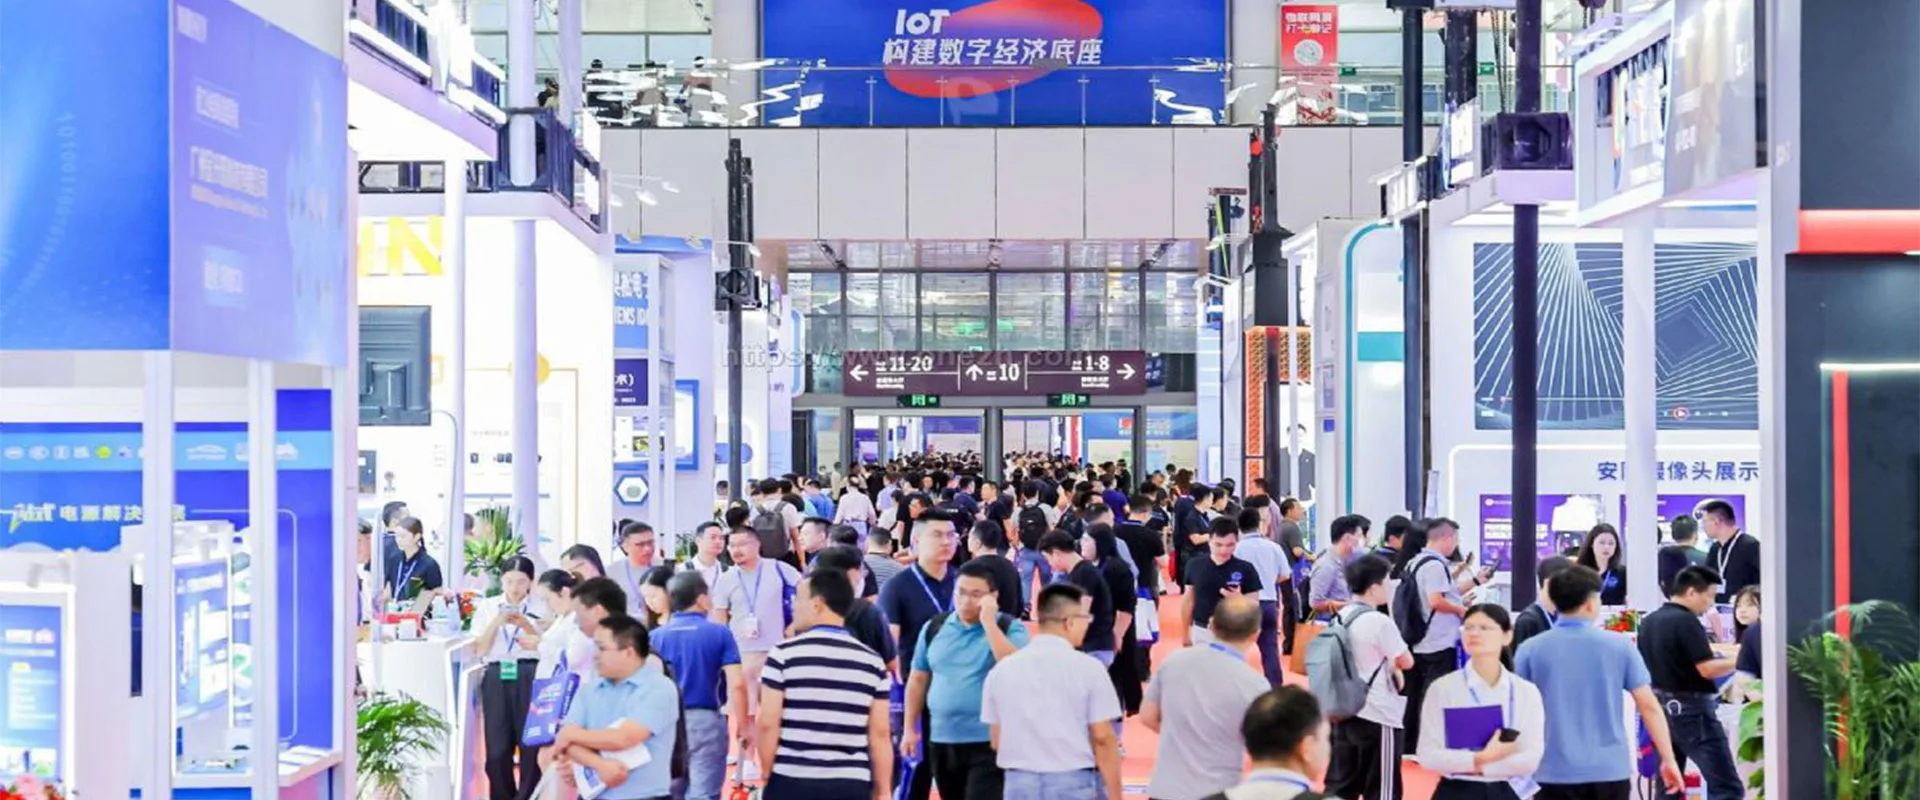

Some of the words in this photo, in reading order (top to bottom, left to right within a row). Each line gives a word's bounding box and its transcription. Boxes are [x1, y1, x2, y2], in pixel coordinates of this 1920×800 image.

[895, 9, 950, 35] IoT
[882, 38, 1103, 65] 构建数字经济底座
[889, 356, 933, 371] 11-20
[999, 363, 1020, 381] 10
[1086, 355, 1110, 371] 1-8
